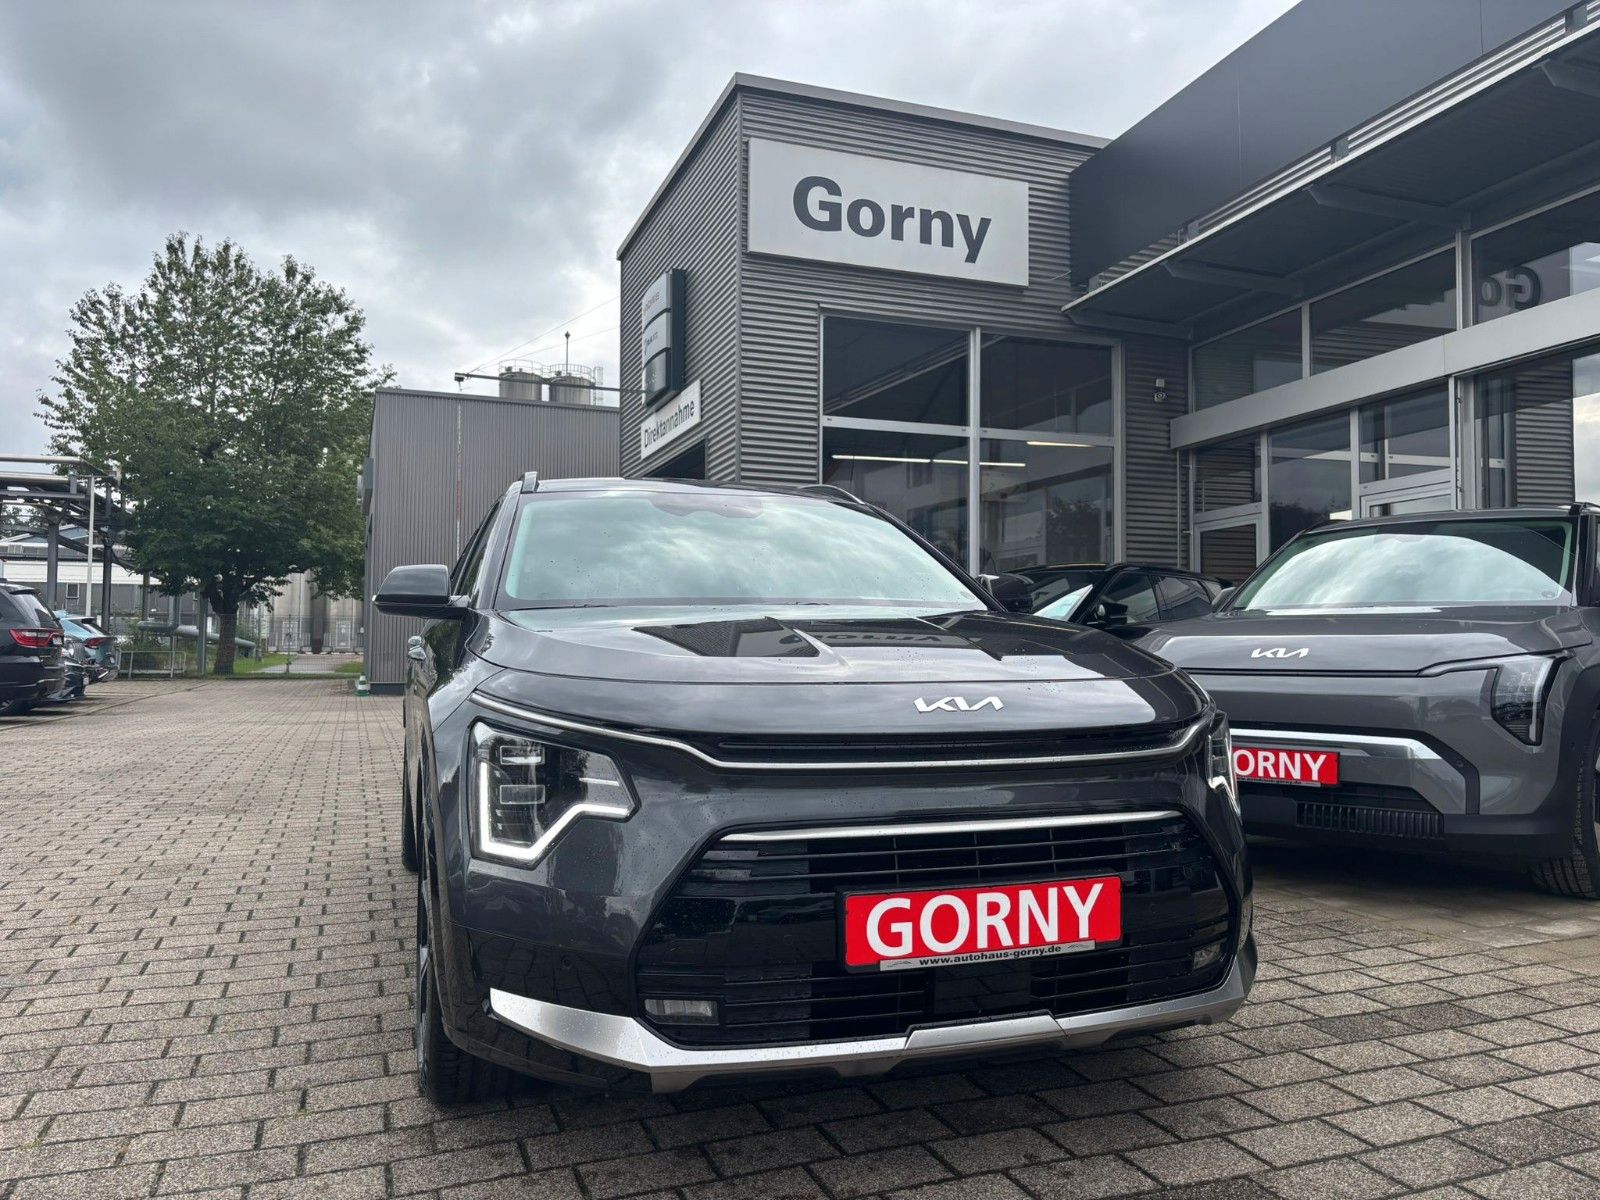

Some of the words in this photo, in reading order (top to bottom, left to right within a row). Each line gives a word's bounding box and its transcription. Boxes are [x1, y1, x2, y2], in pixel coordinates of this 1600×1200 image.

[792, 175, 992, 264] Gorny
[644, 400, 695, 448] Direktannahme
[1250, 647, 1310, 659] KIA
[913, 695, 1005, 714] KIA
[1232, 749, 1327, 781] ORNY
[866, 883, 1104, 957] GORNY
[919, 945, 1062, 967] www.autohaus-gorny.de
